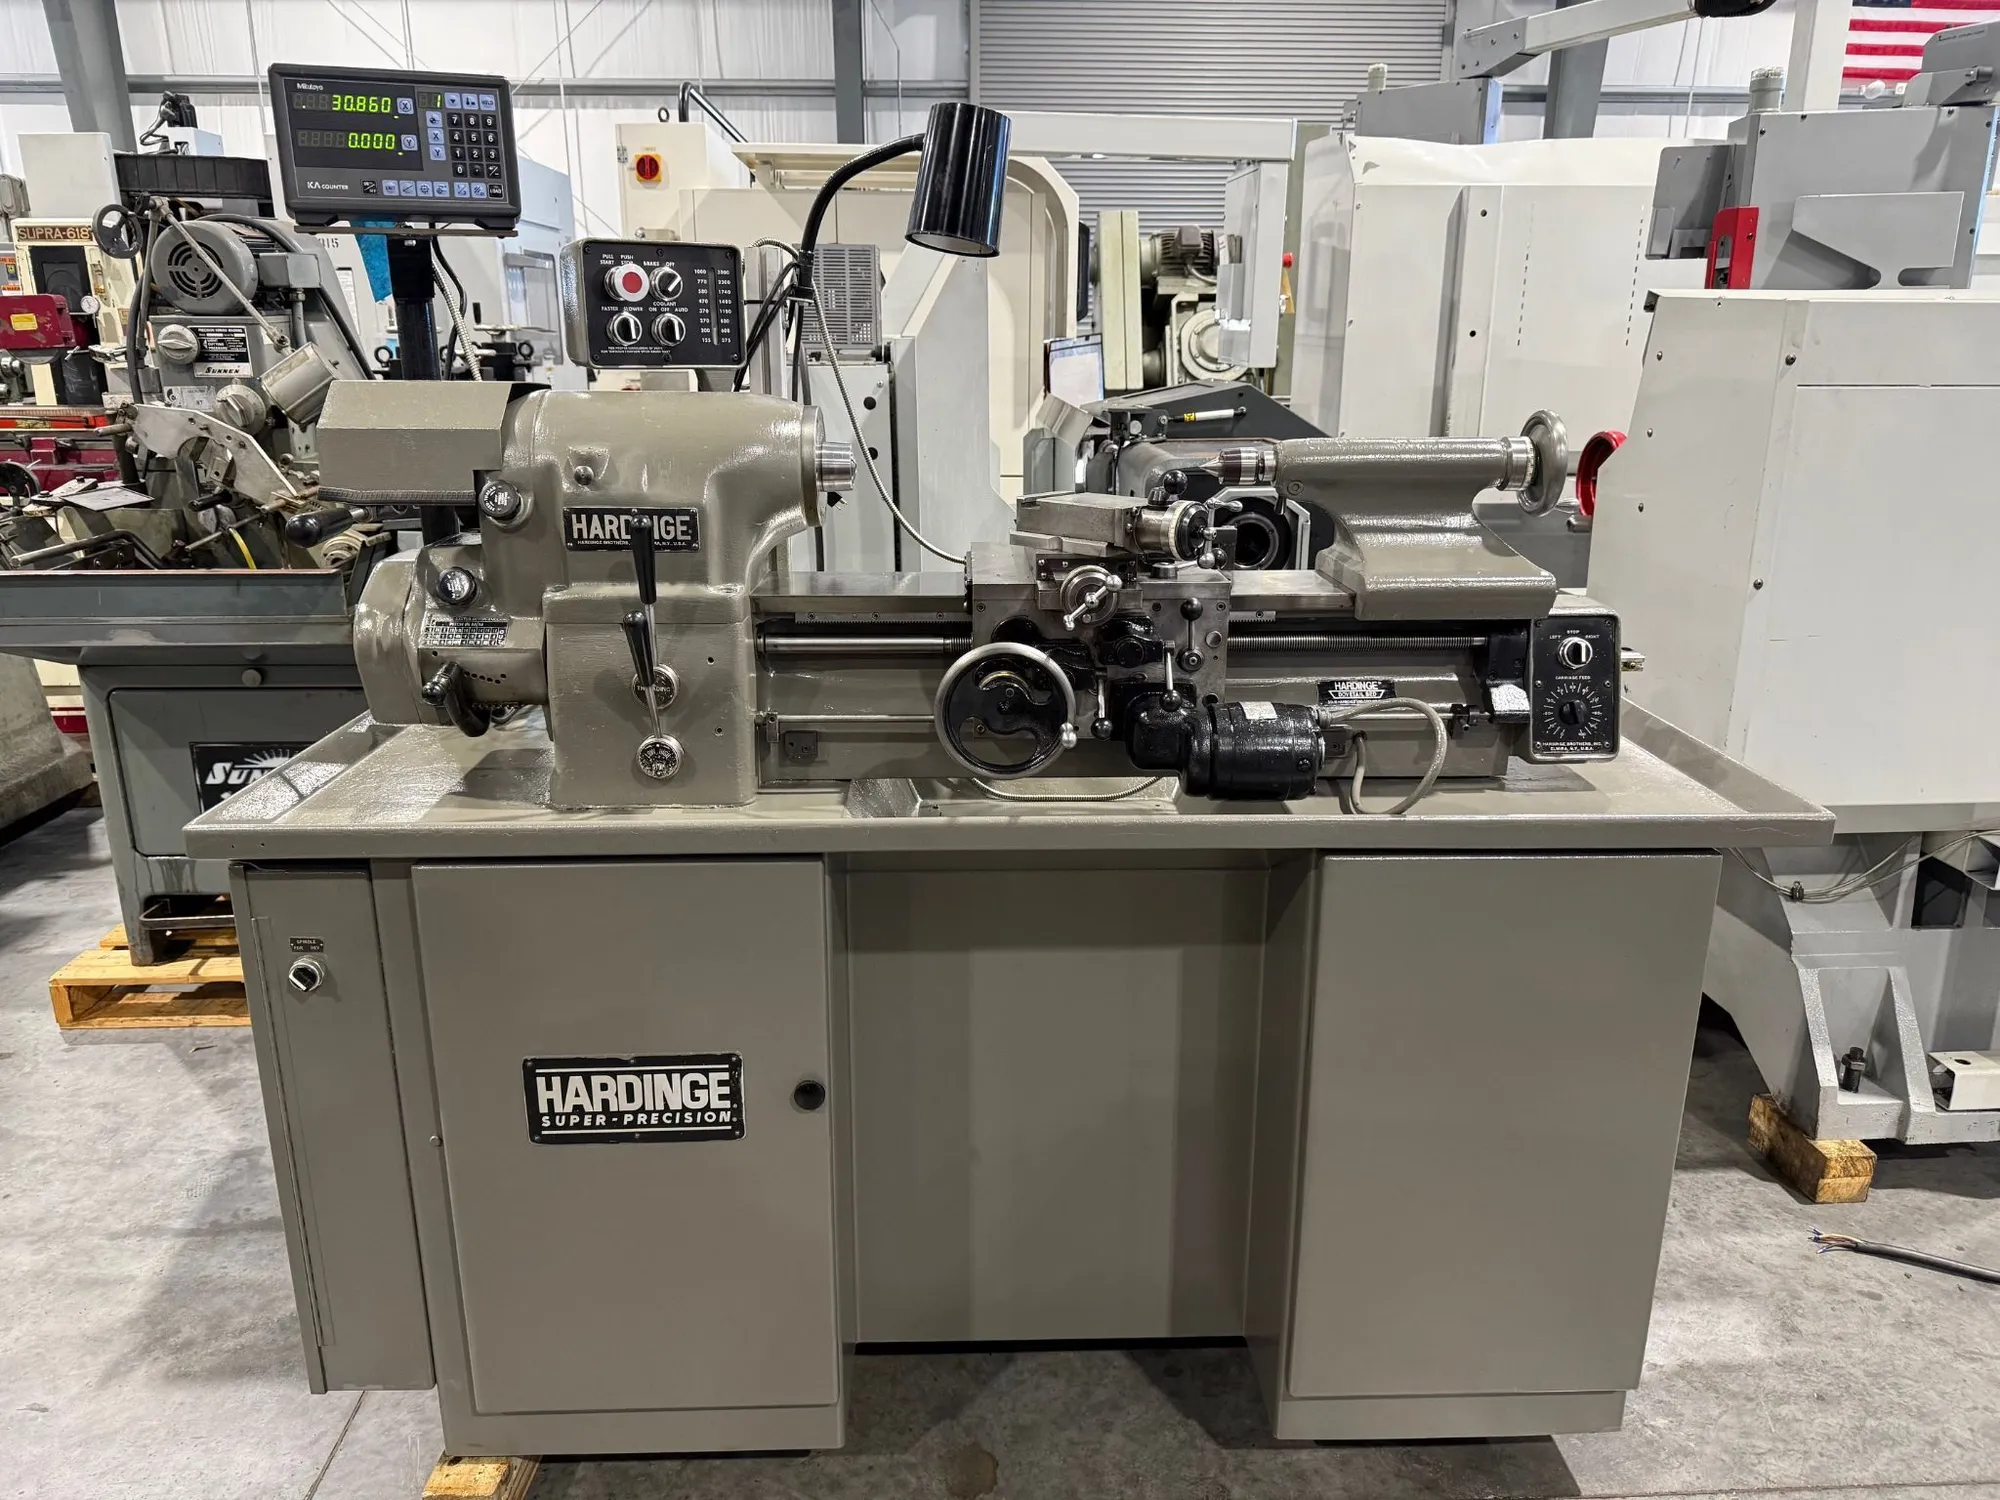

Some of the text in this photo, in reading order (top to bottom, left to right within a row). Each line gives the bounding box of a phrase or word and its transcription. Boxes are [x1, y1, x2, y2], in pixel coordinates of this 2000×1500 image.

[332, 94, 391, 113] 30.860
[453, 116, 458, 124] 7
[469, 117, 475, 125] 8
[486, 118, 492, 126] 9
[433, 132, 439, 140] X
[348, 132, 396, 150] 0.000
[457, 166, 463, 174] 0
[571, 514, 692, 540] HARDGE
[1334, 681, 1378, 690] HARDINGE
[205, 762, 269, 785] SUN
[536, 1071, 732, 1114] HARDINGE
